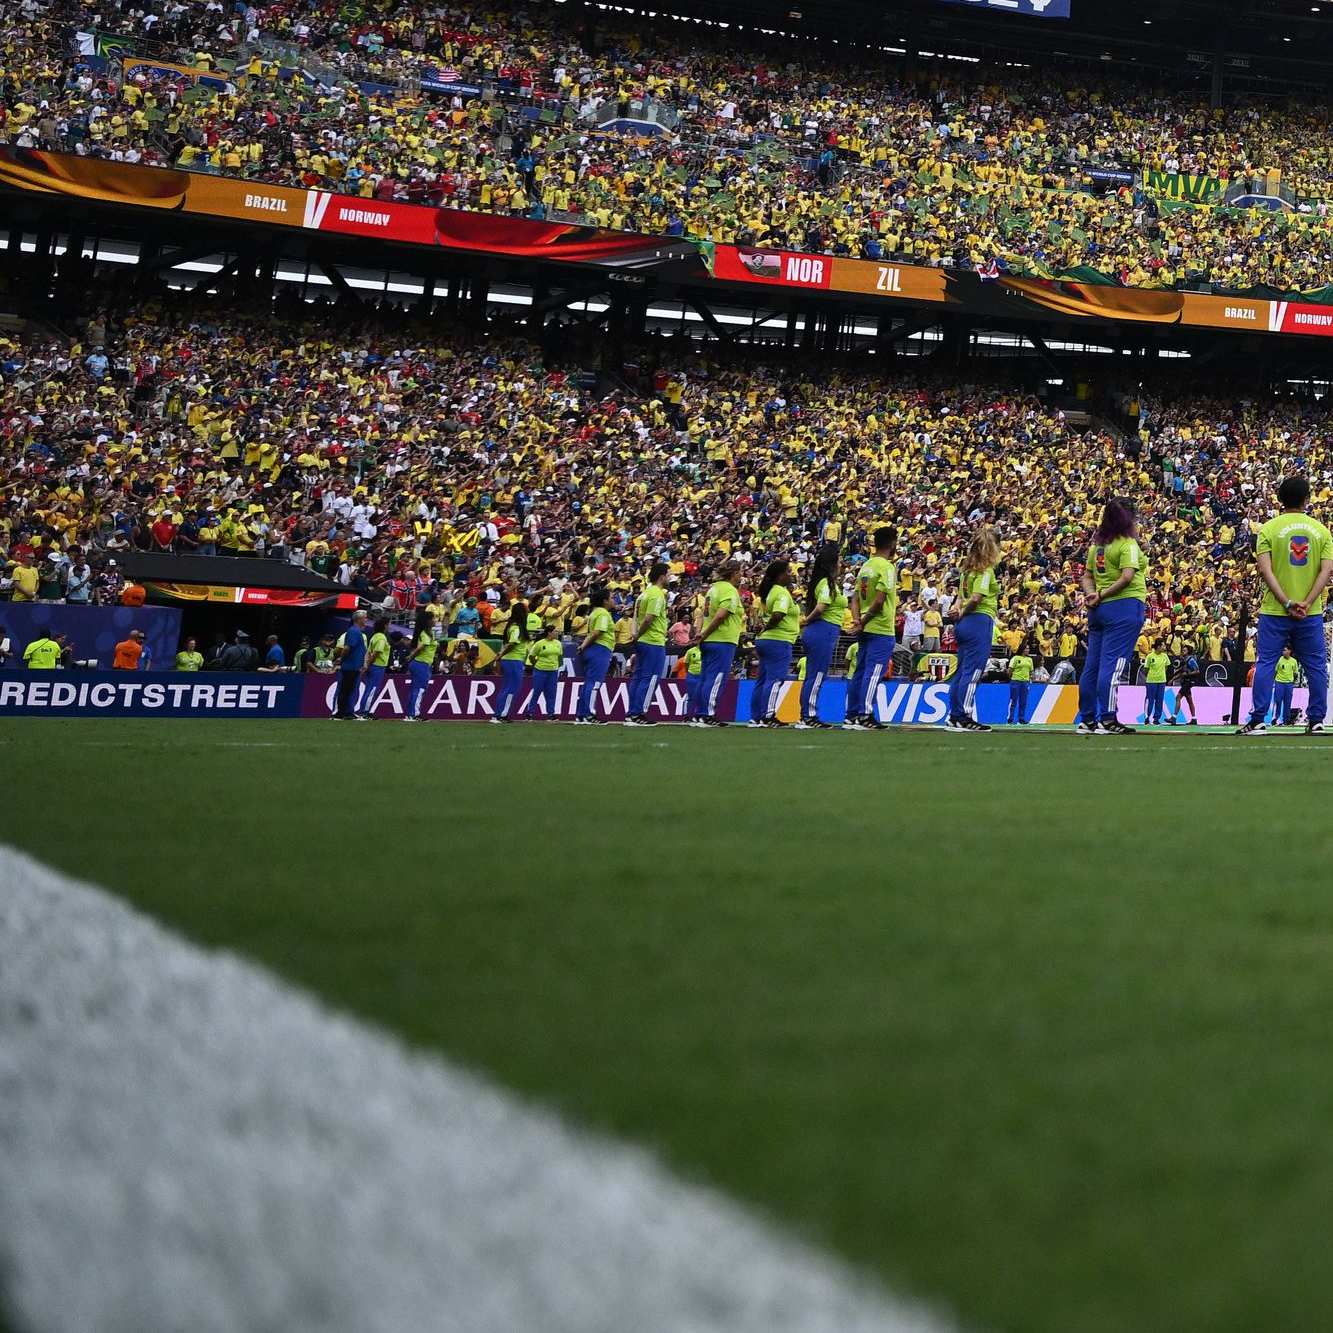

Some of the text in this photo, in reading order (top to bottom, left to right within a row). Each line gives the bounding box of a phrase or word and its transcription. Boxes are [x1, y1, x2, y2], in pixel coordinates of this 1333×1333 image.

[245, 194, 287, 212] BRAZIL
[339, 208, 390, 226] NORWAY
[786, 257, 823, 284] NOR
[877, 267, 901, 292] ZIL
[1224, 307, 1256, 320] BRAZIL
[1294, 313, 1333, 326] NORWAY
[1279, 522, 1321, 539] VOLUNTEER
[0, 681, 285, 708] REDICTSTREET
[325, 678, 690, 716] AAR AIWAY
[876, 683, 978, 724] VIS
